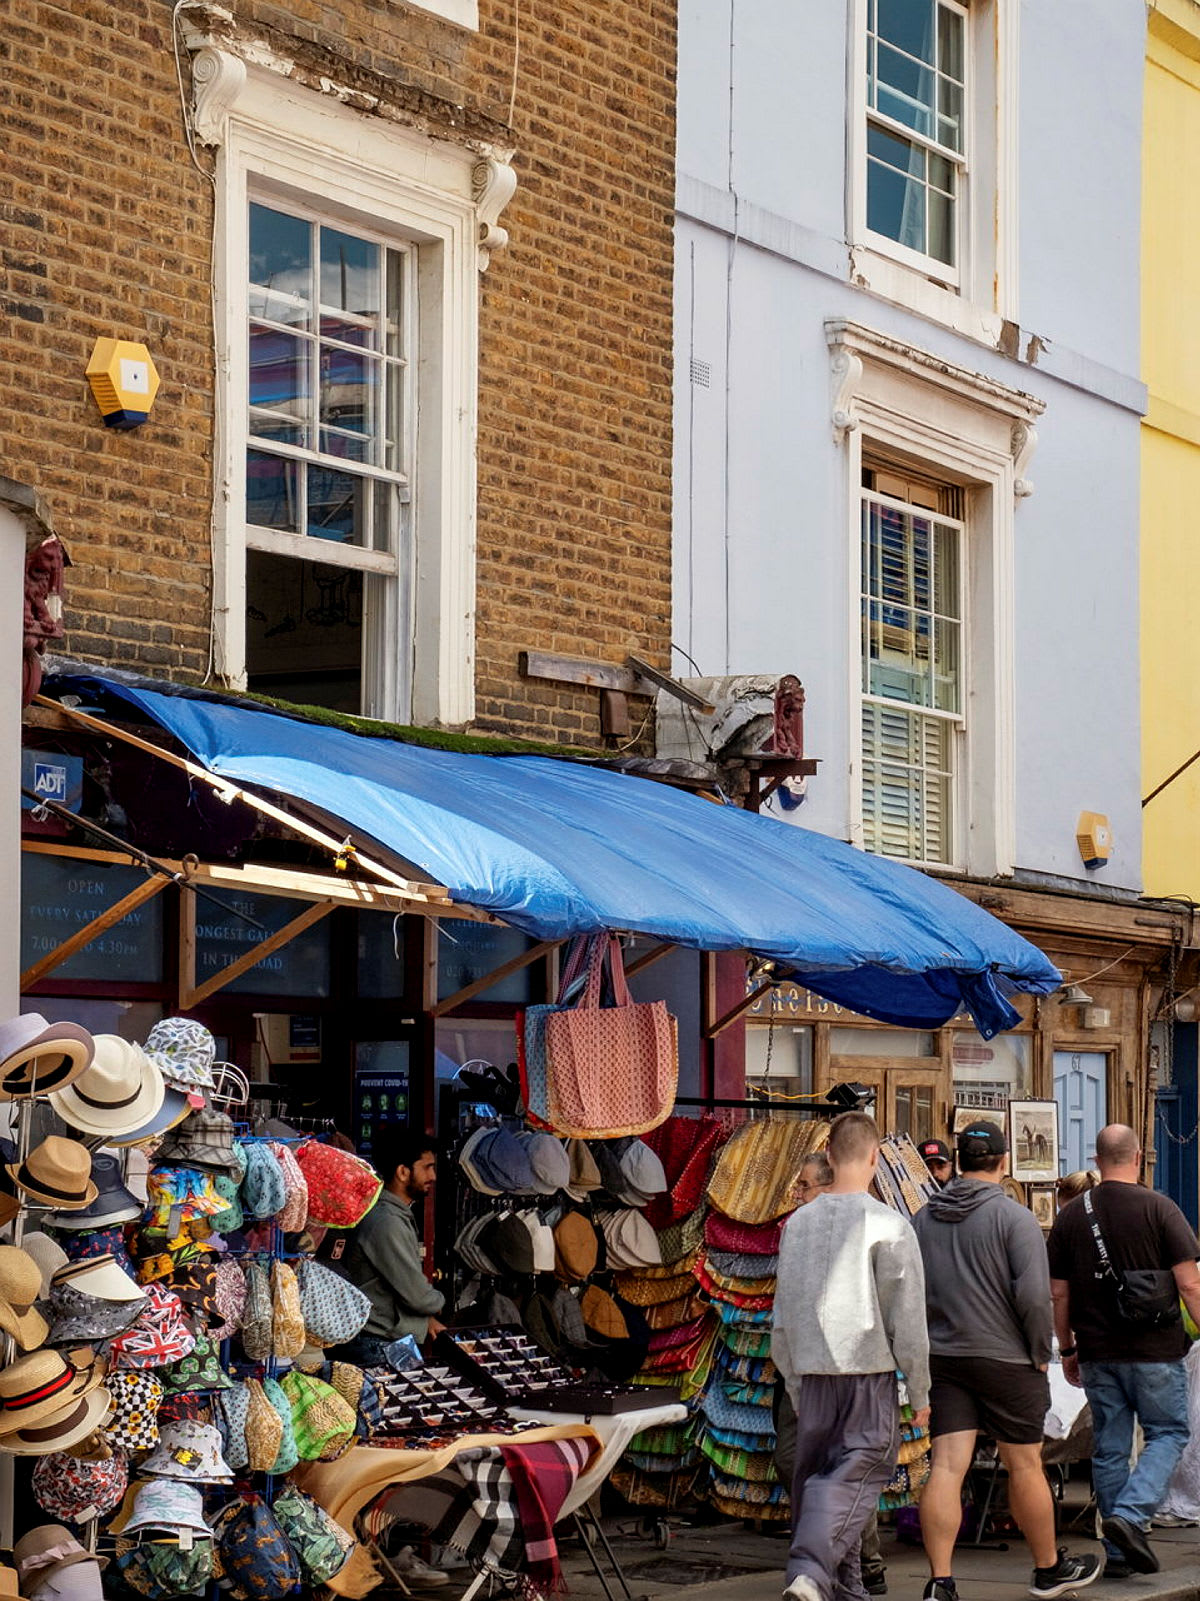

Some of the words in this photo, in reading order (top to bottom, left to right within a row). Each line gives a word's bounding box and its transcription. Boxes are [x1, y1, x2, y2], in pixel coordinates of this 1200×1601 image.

[35, 773, 64, 793] ADT
[68, 879, 104, 895] OPEN
[196, 925, 243, 940] ONGEST
[254, 957, 282, 969] OAD
